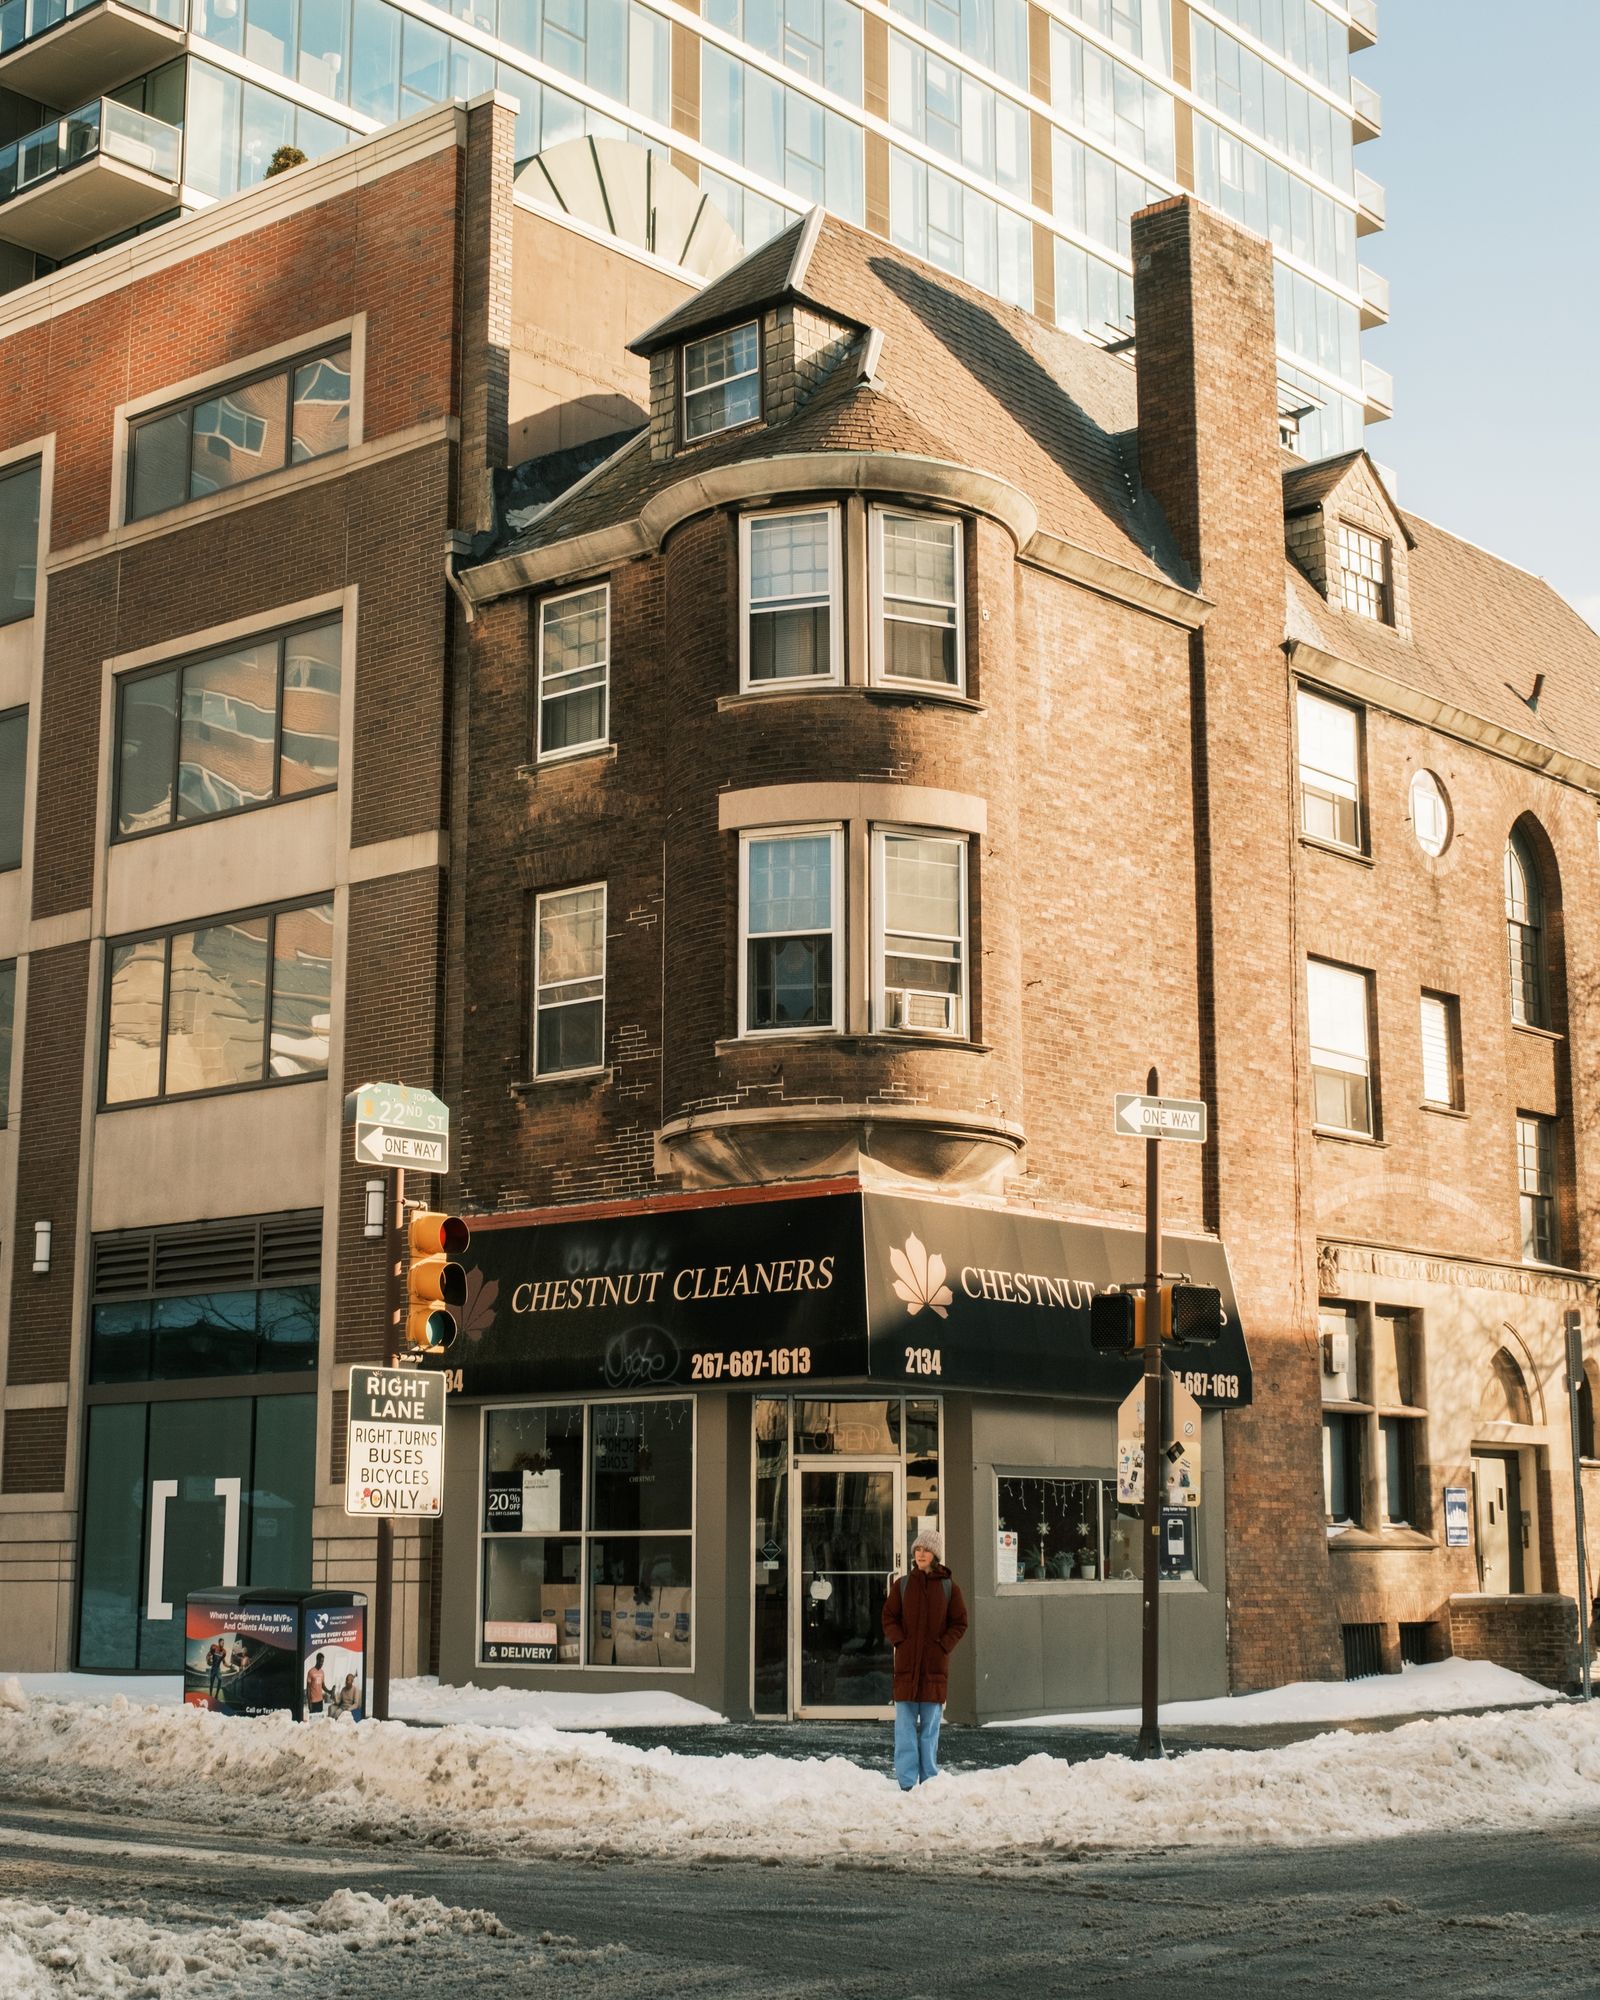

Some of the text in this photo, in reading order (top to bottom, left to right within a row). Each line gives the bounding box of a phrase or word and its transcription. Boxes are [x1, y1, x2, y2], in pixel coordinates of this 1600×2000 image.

[379, 1100, 445, 1130] 22ND ST
[1143, 1109, 1196, 1128] ONE WAY
[384, 1138, 438, 1159] ONE WAY
[511, 1256, 835, 1314] CHESTNUT CLEANERS
[960, 1266, 1095, 1311] CHESTNUT
[691, 1346, 811, 1379] 267-687-1613
[905, 1347, 942, 1376] 2134
[367, 1376, 430, 1398] RIGHT
[446, 1369, 464, 1393] 34
[1171, 1370, 1239, 1398] 7-687-1613
[371, 1399, 425, 1420] LANE
[355, 1428, 438, 1446] RIGHT TURNS
[813, 1429, 876, 1450] OPEN
[369, 1448, 423, 1465] BUSES
[360, 1468, 429, 1485] BICYCLES
[369, 1488, 420, 1510] ONLY
[509, 1503, 521, 1511] OFF
[209, 1611, 228, 1620] Where
[229, 1612, 261, 1622] Caregivers
[261, 1613, 273, 1622] Are
[223, 1622, 293, 1634] And Clients Always Win
[489, 1646, 498, 1657] &
[501, 1647, 552, 1659] DELIVERY
